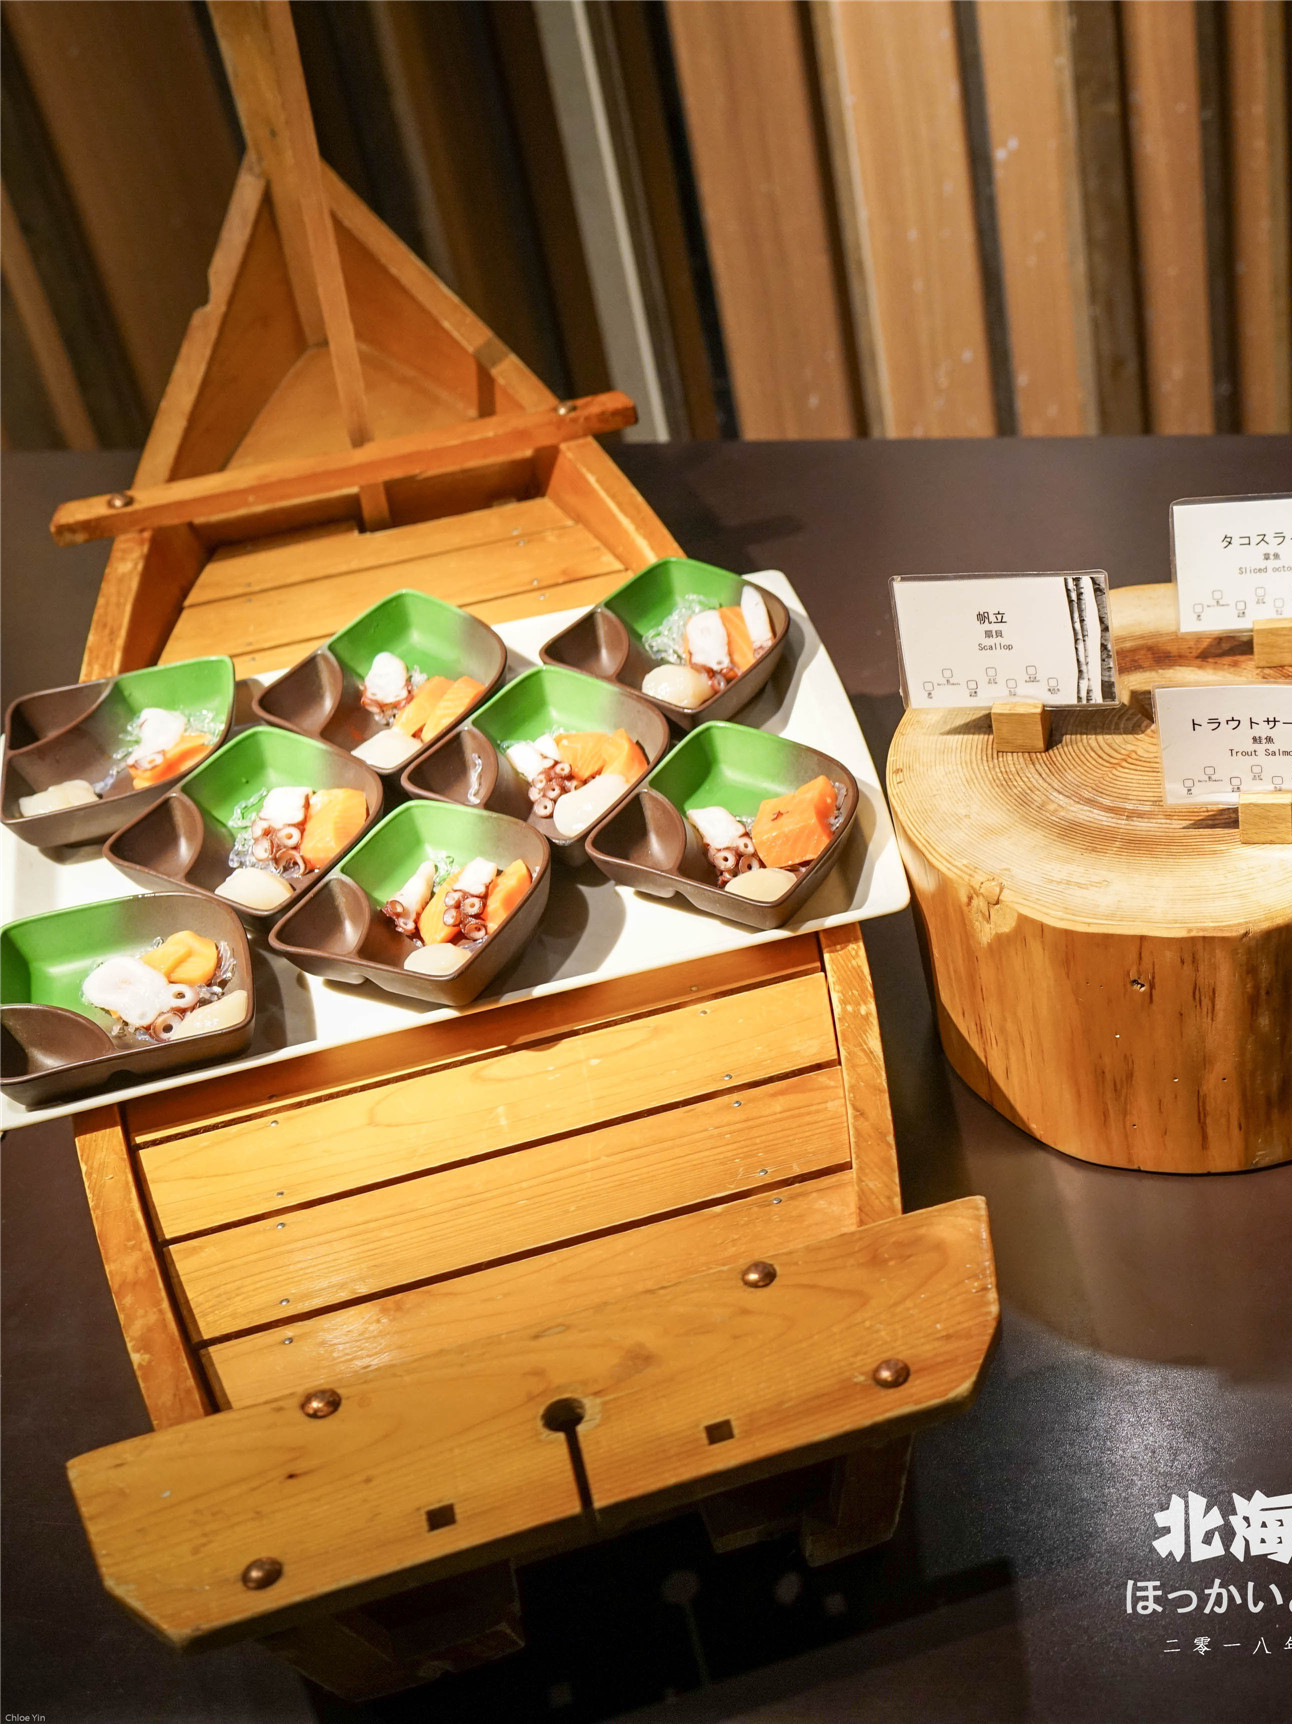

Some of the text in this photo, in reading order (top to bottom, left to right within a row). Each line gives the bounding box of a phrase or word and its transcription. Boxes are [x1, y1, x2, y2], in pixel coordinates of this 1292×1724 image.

[1262, 551, 1281, 561] 章魚
[1238, 566, 1268, 575] Sliced
[976, 611, 1007, 625] 帆立
[978, 642, 1013, 651] Scallop
[1252, 735, 1275, 745] 鮭魚
[1229, 748, 1259, 757] Trout
